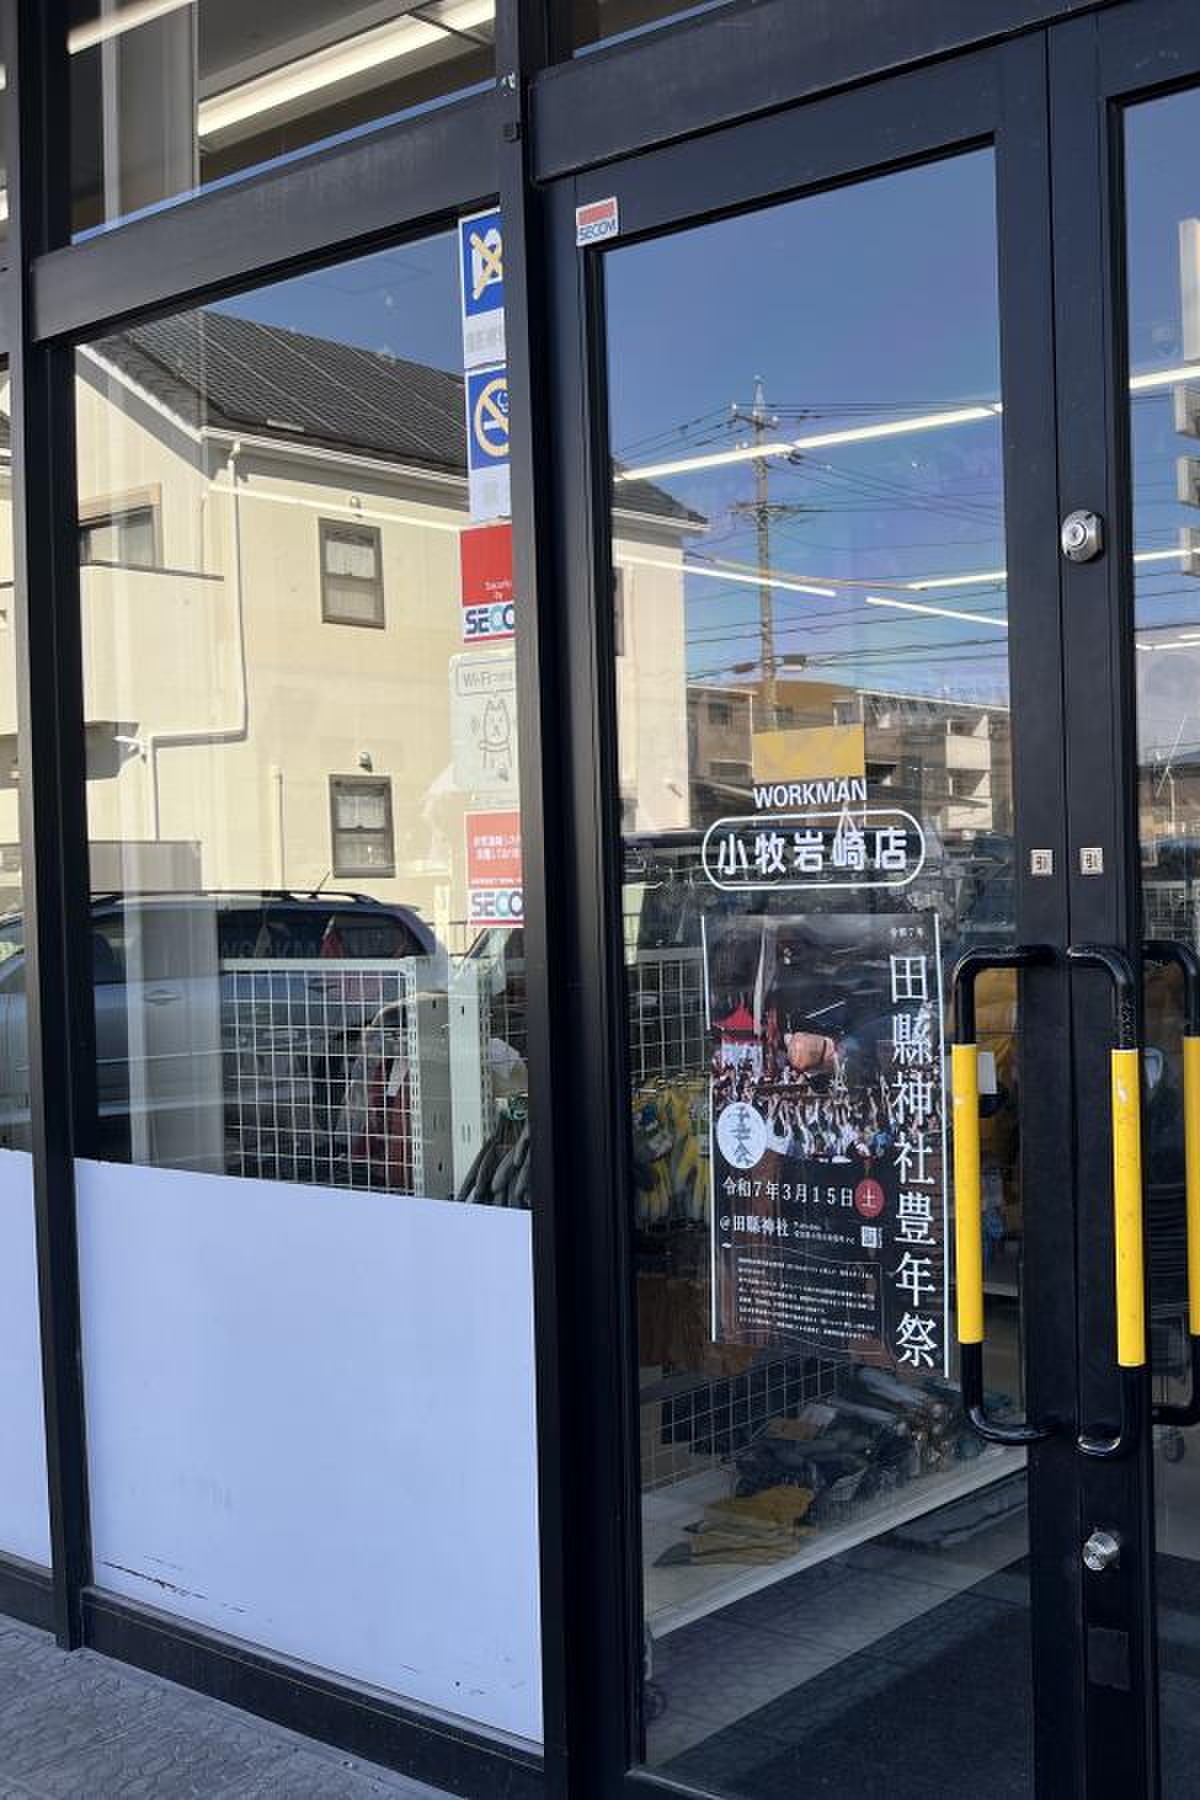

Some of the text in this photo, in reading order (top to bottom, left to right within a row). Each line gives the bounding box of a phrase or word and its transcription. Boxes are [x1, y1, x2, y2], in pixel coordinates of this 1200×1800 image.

[579, 218, 616, 241] SECOM
[752, 778, 868, 809] WORKMAN
[717, 827, 907, 875] 小牧岩崎店
[888, 954, 937, 1368] 田縣神社豊年祭
